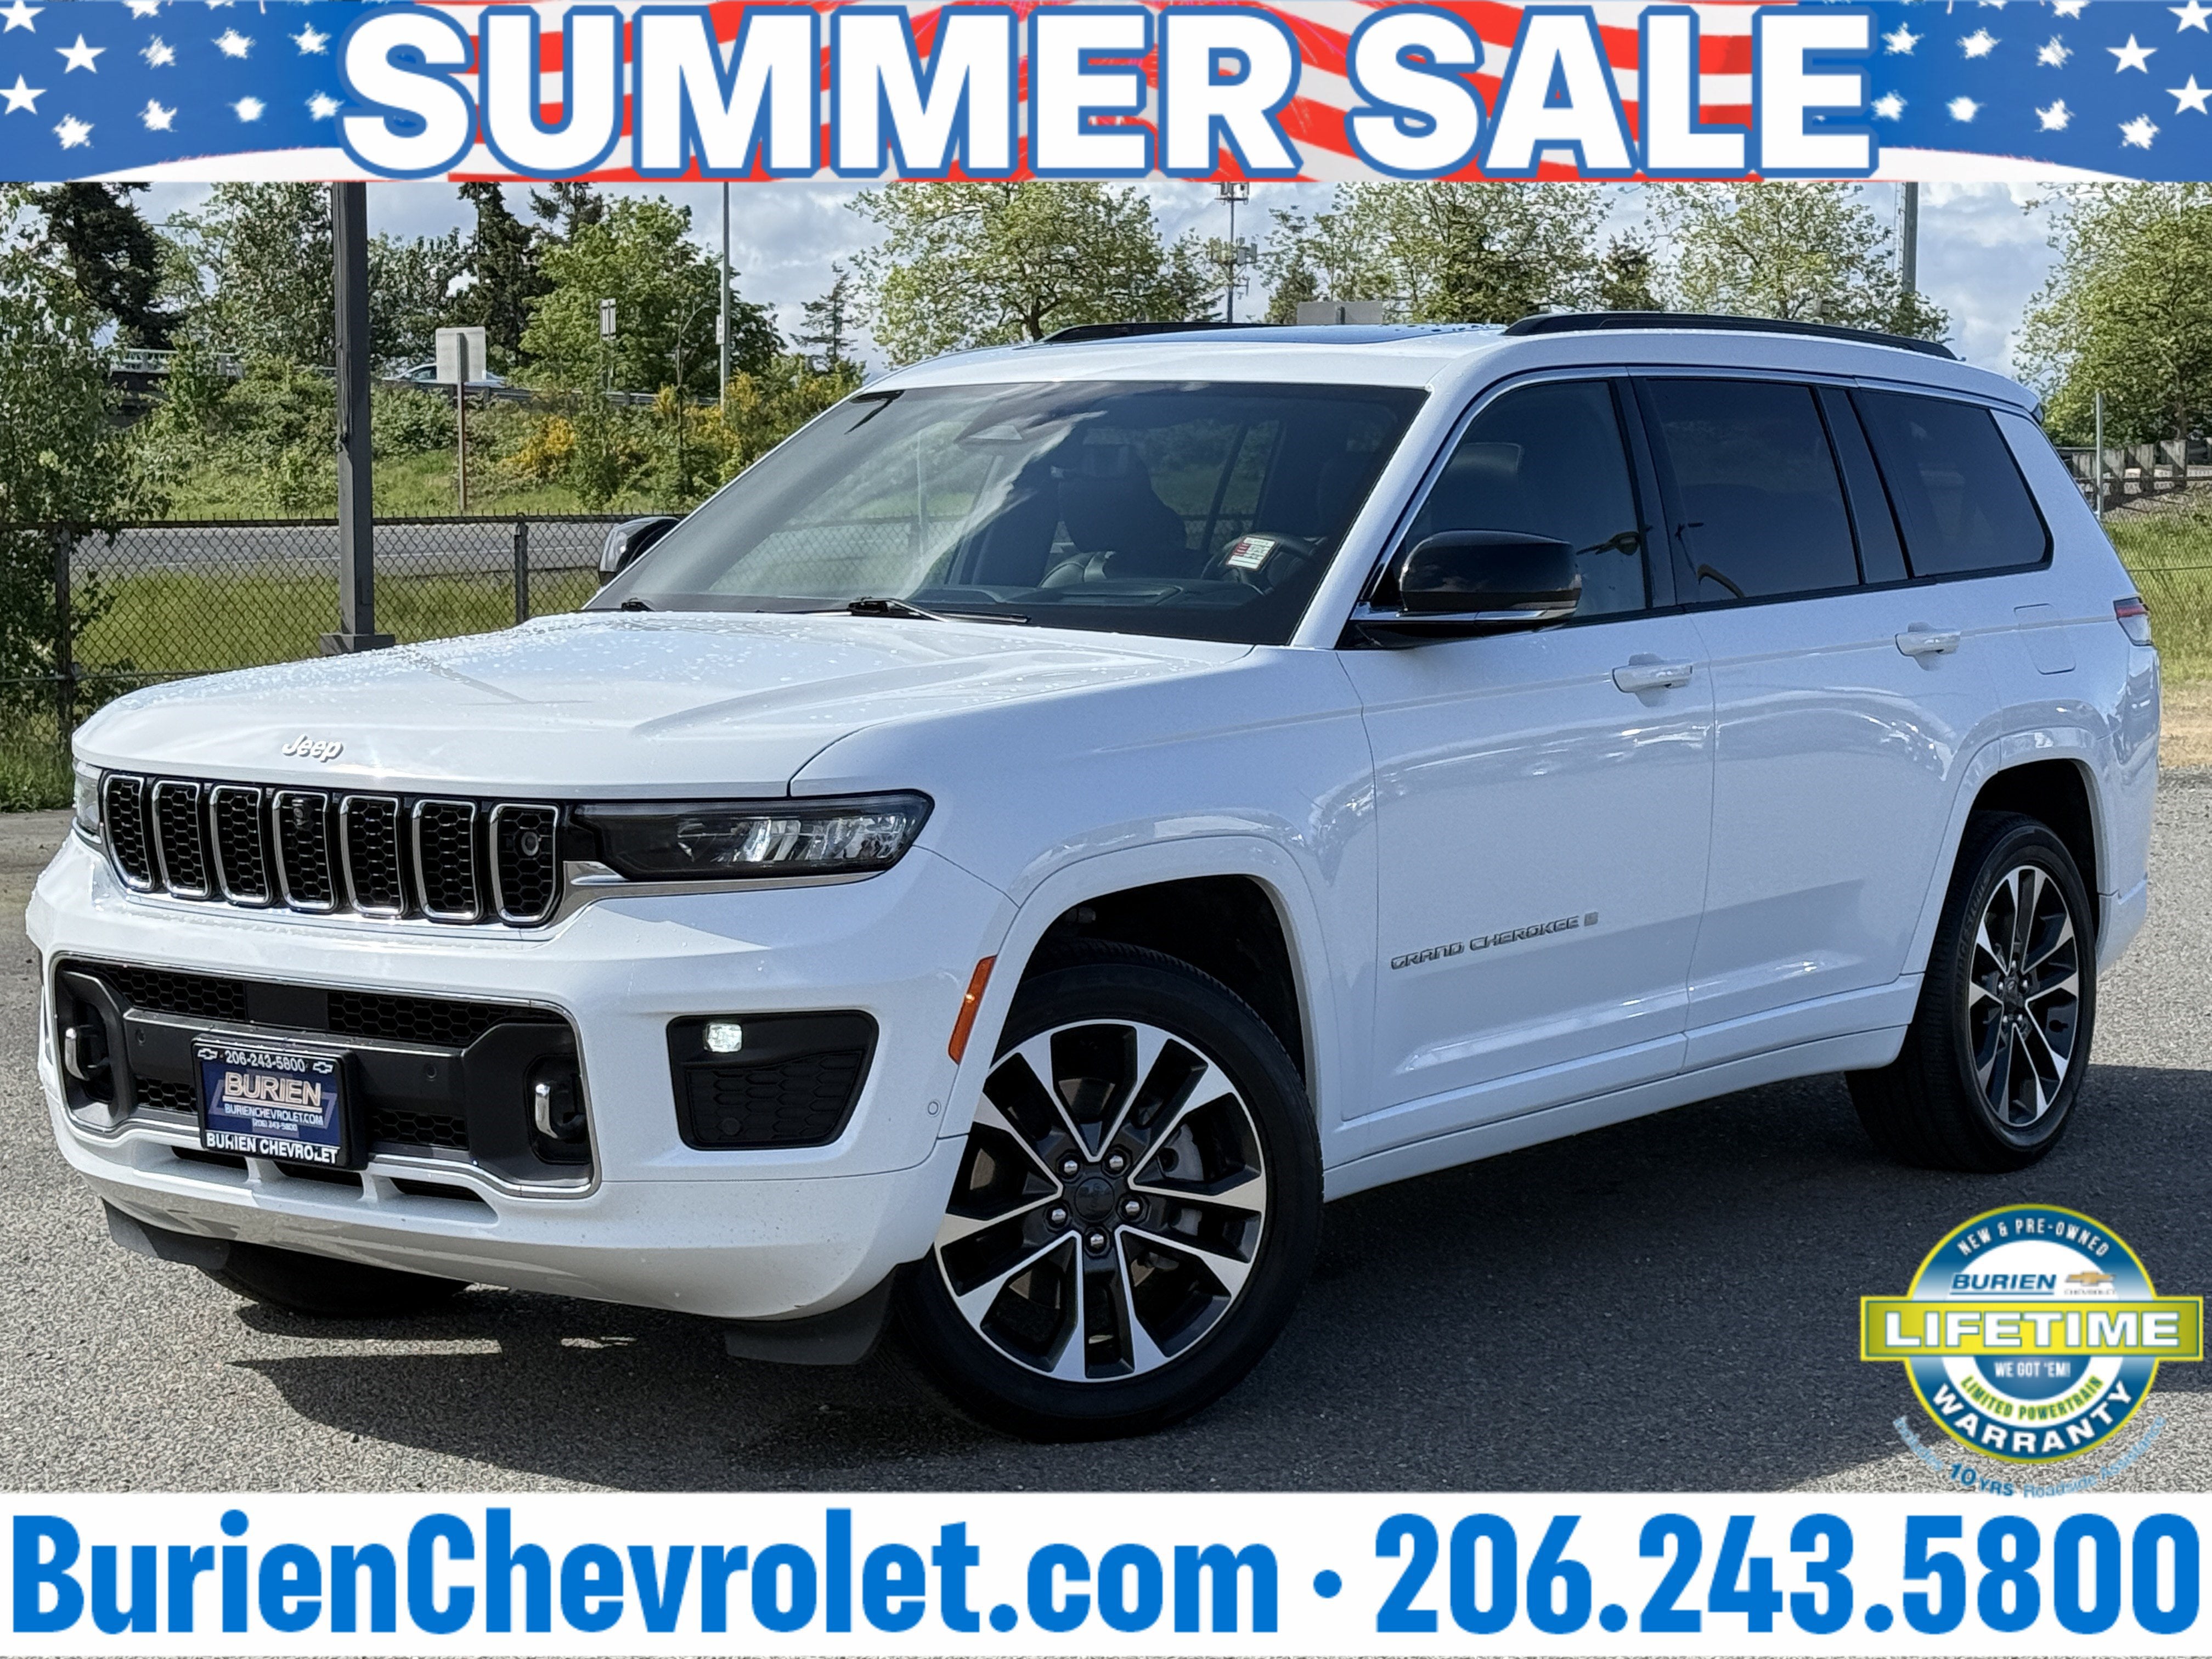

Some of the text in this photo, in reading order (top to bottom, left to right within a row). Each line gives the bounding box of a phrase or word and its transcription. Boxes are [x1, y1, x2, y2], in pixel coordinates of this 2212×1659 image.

[281, 733, 344, 763] Jeep
[1391, 941, 1465, 970] GRAND
[1469, 915, 1580, 951] CHEROKEE
[224, 1049, 307, 1073] 206-243-5800
[224, 1071, 322, 1108] BURIEN
[224, 1103, 324, 1126] BURIENCHEVROLET.COM
[206, 1132, 339, 1164] BURIEN CHEVROLET
